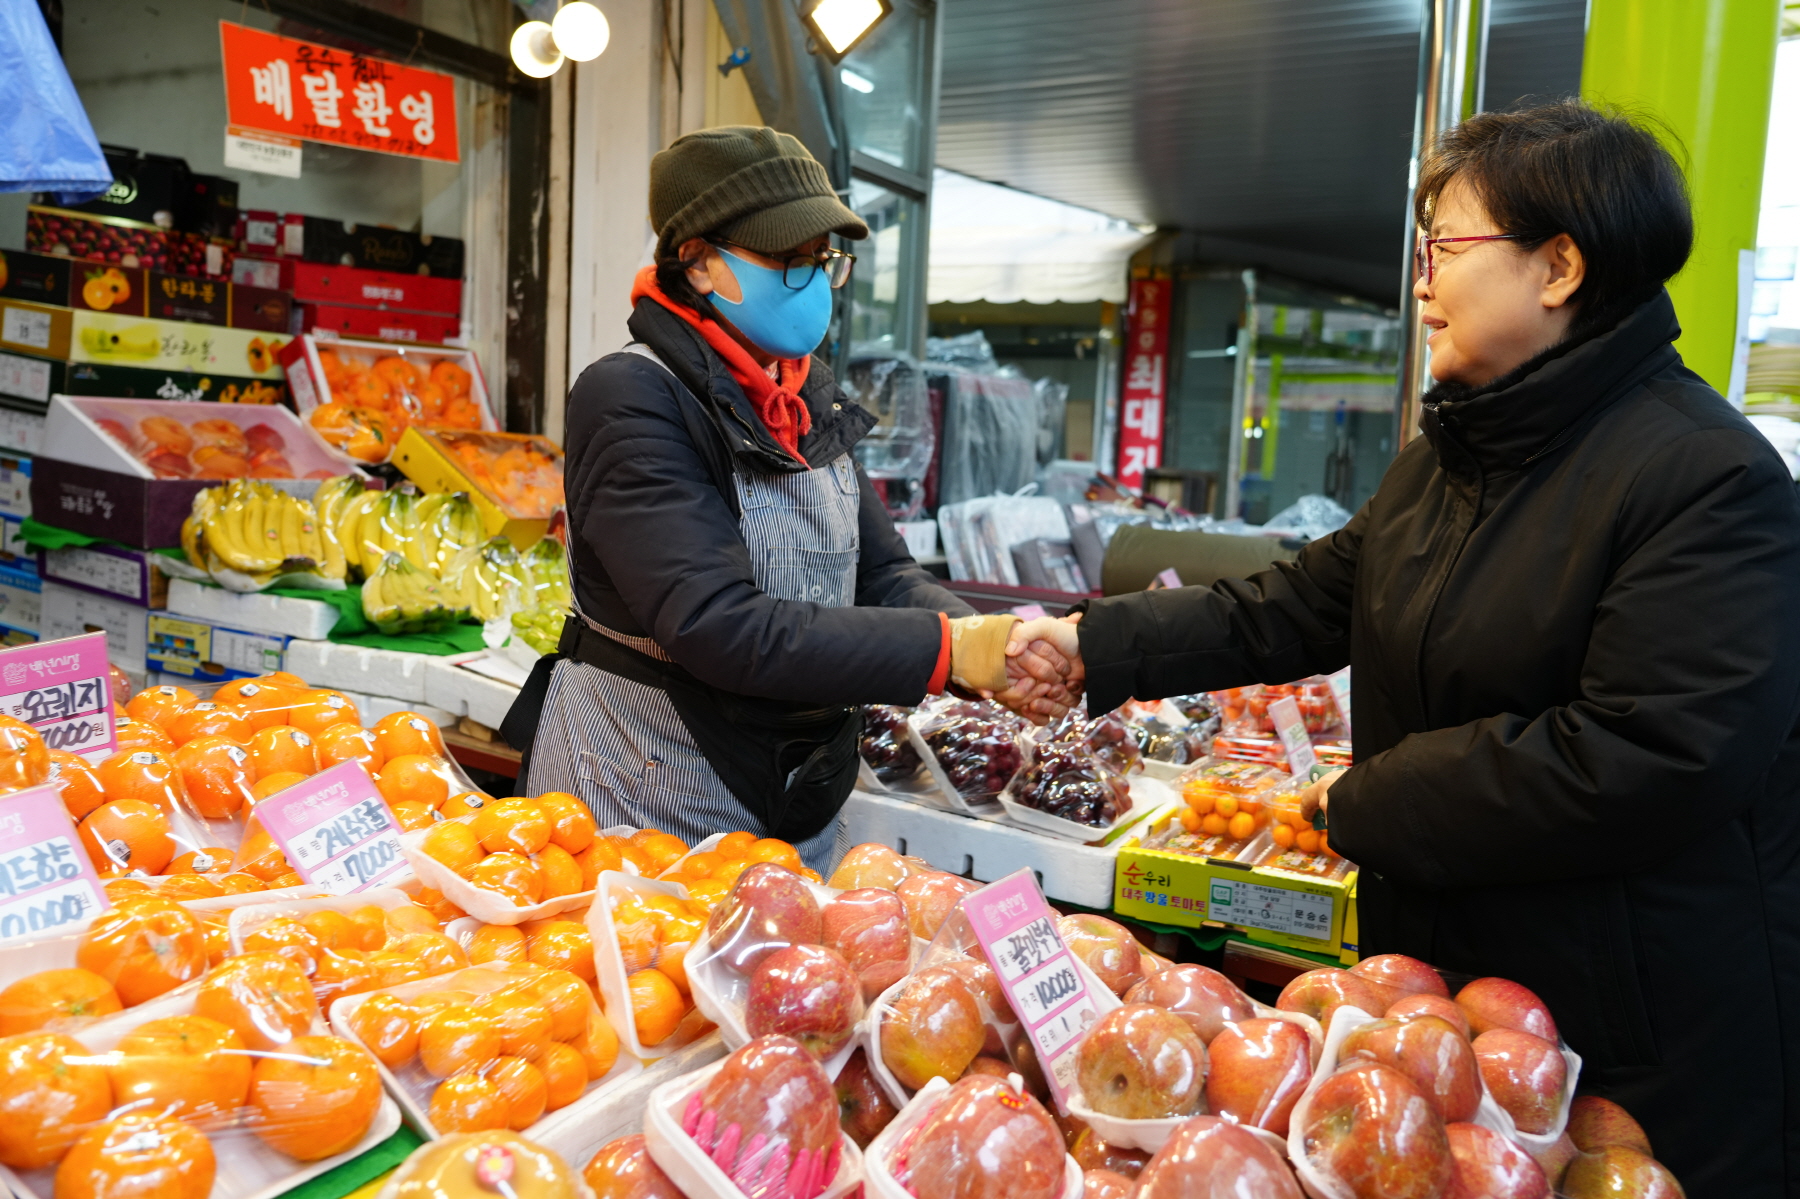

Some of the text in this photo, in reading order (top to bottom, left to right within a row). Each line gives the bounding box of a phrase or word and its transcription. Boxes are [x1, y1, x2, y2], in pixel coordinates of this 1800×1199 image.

[161, 277, 215, 304] 한라봉
[161, 333, 214, 362] 한라봉
[28, 653, 81, 677] 백년시장
[23, 677, 105, 725] 오렌지
[303, 781, 349, 811] 백년시장
